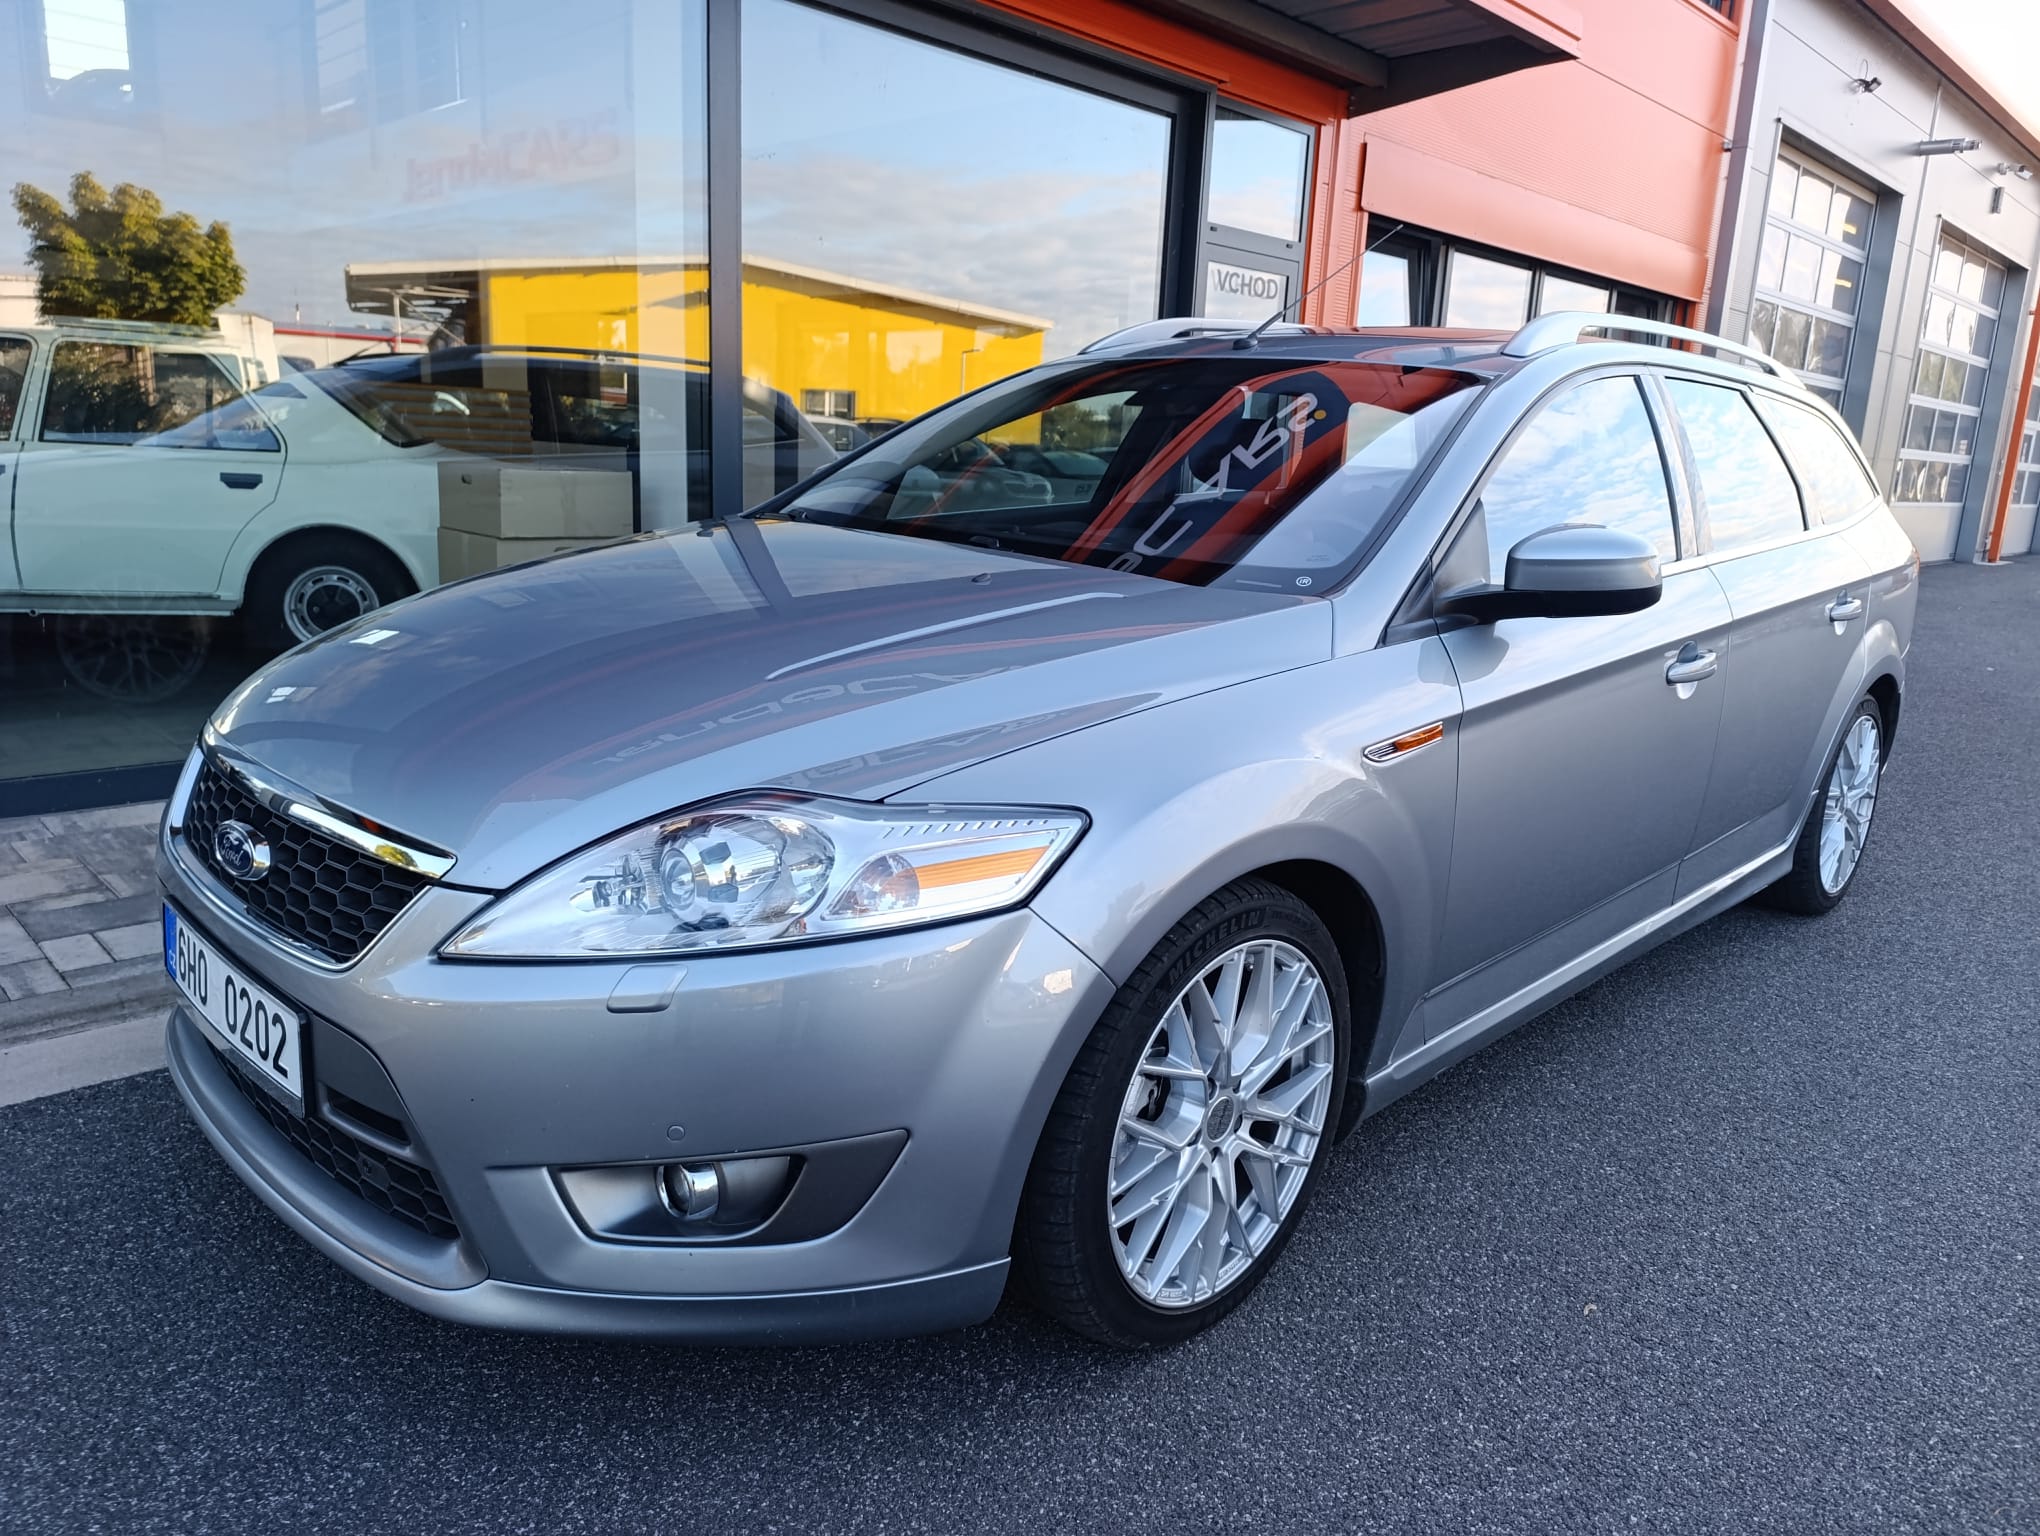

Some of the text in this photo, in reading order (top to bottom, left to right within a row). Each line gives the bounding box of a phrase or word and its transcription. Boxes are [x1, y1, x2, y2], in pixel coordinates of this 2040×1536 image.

[1216, 269, 1278, 299] VCHOD
[220, 834, 243, 866] Ford
[169, 949, 177, 969] CZ
[1169, 910, 1261, 985] MICHELIN
[225, 974, 289, 1080] 0202
